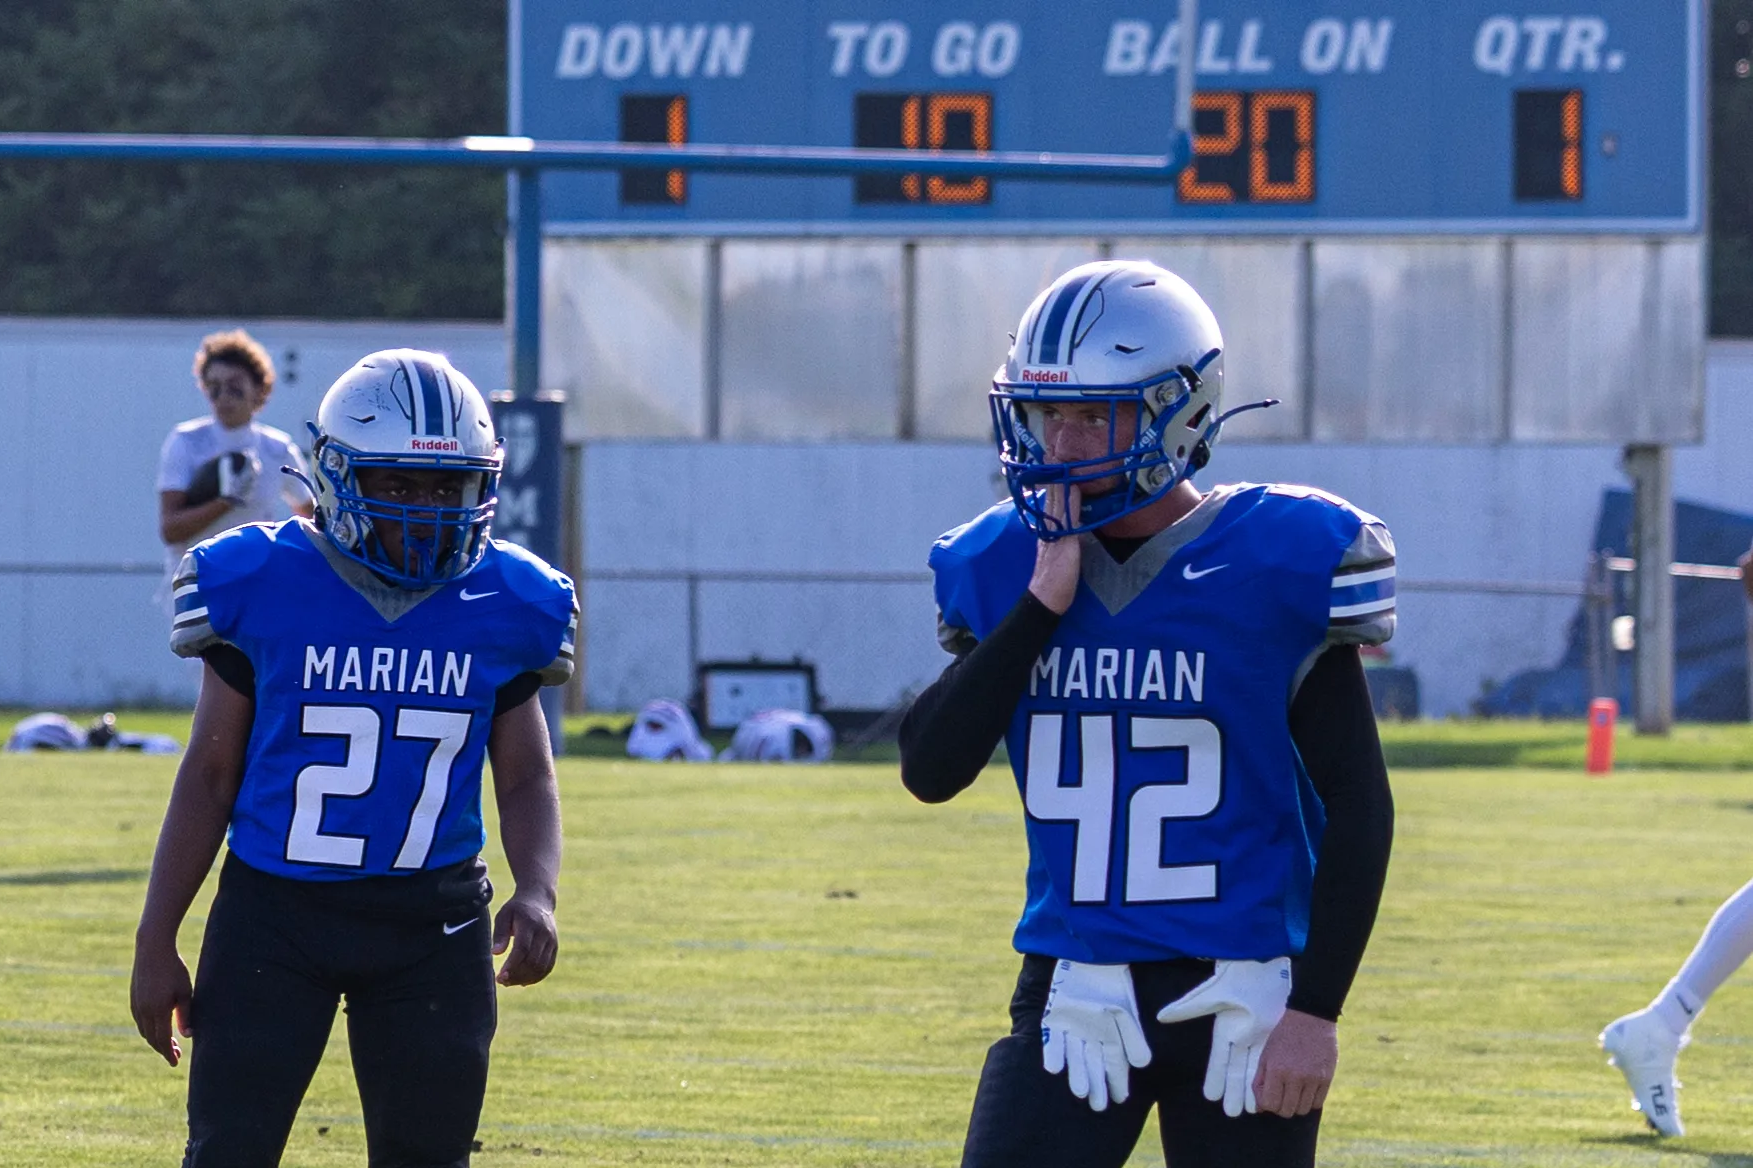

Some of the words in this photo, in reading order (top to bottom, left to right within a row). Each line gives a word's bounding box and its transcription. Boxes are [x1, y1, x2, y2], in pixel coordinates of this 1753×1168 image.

[555, 23, 754, 80] DOWN
[826, 21, 911, 78] TO
[931, 20, 1022, 78] GO
[1102, 19, 1273, 76] BALL
[1298, 19, 1395, 74] ON
[1473, 16, 1626, 76] QTR.
[666, 94, 688, 202] 1
[901, 93, 991, 202] 10
[1178, 90, 1315, 203] 20
[1560, 90, 1583, 198] 1
[1022, 369, 1068, 383] Riddell
[411, 439, 458, 451] Riddell
[303, 645, 472, 697] MARIAN
[1030, 647, 1205, 702] MARIAN
[285, 704, 473, 870] 27
[1025, 713, 1222, 903] 42
